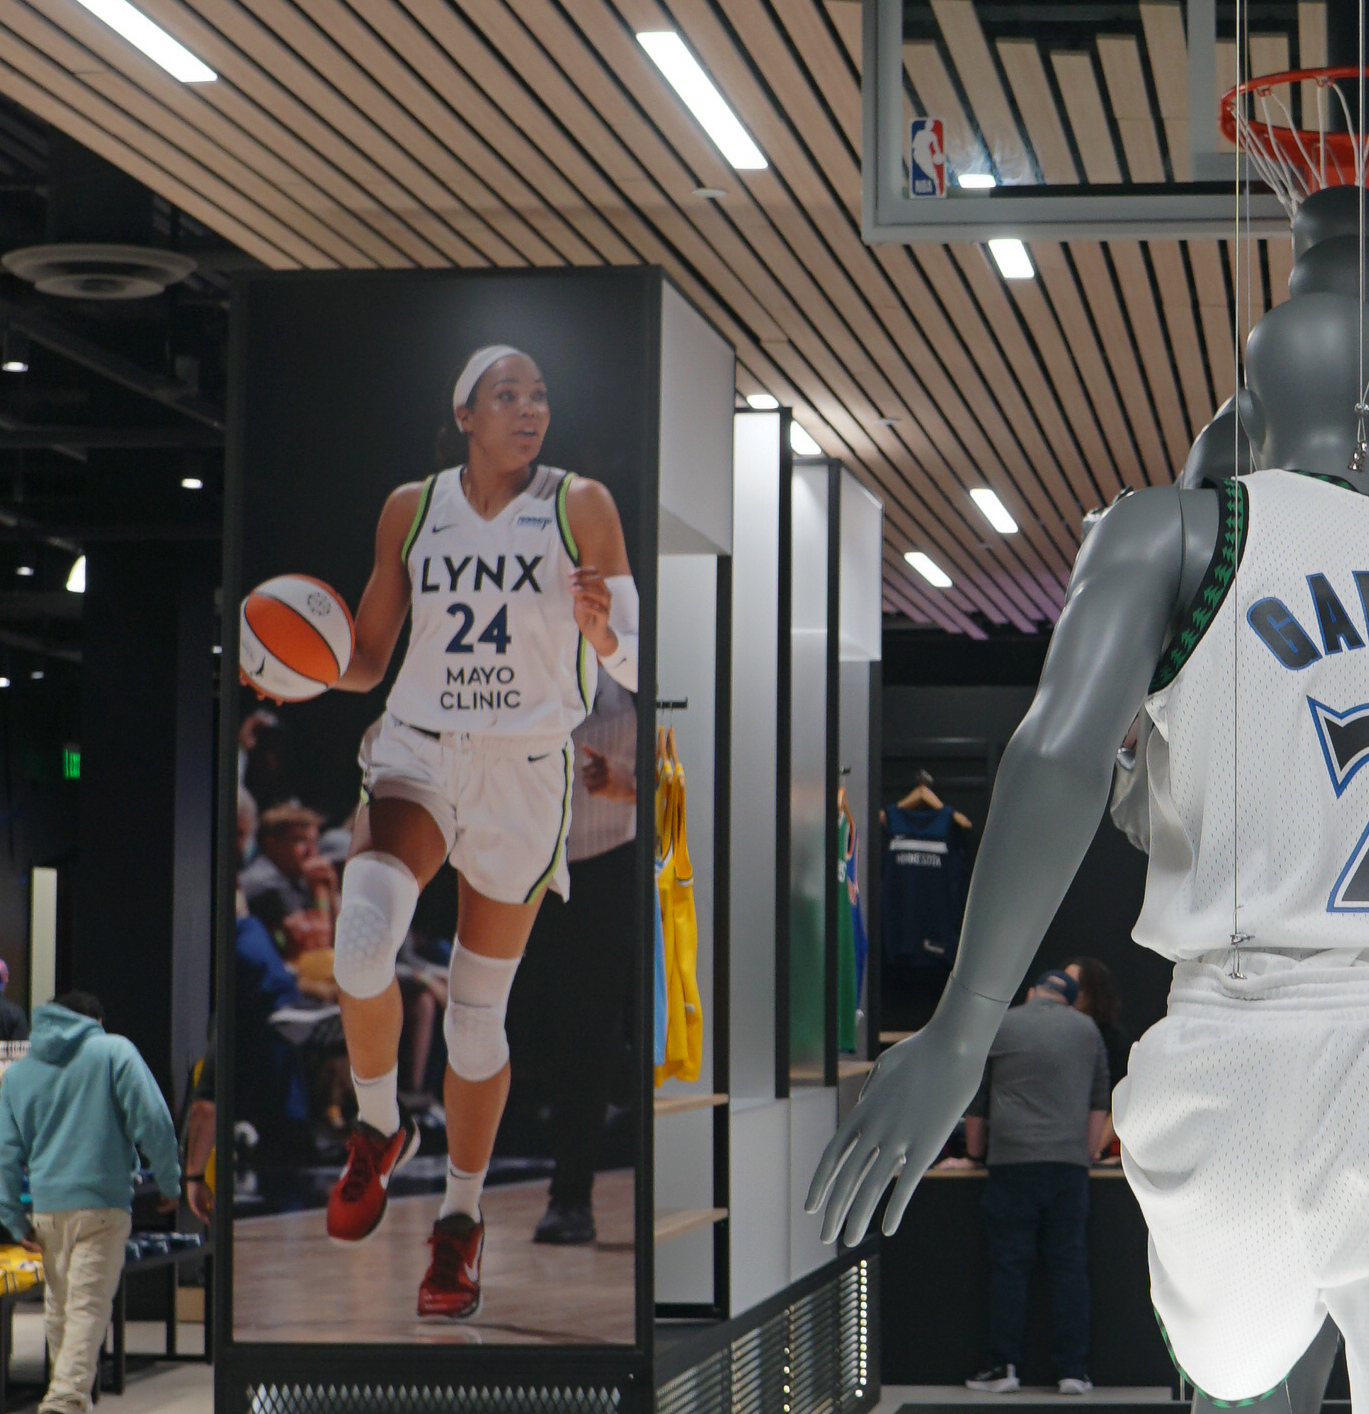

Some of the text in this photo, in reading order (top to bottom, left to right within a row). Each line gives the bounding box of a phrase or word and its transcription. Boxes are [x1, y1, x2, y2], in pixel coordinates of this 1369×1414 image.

[421, 555, 544, 594] LYNX
[445, 602, 512, 655] 24
[446, 666, 515, 685] MAYO
[440, 690, 521, 711] CLINIC
